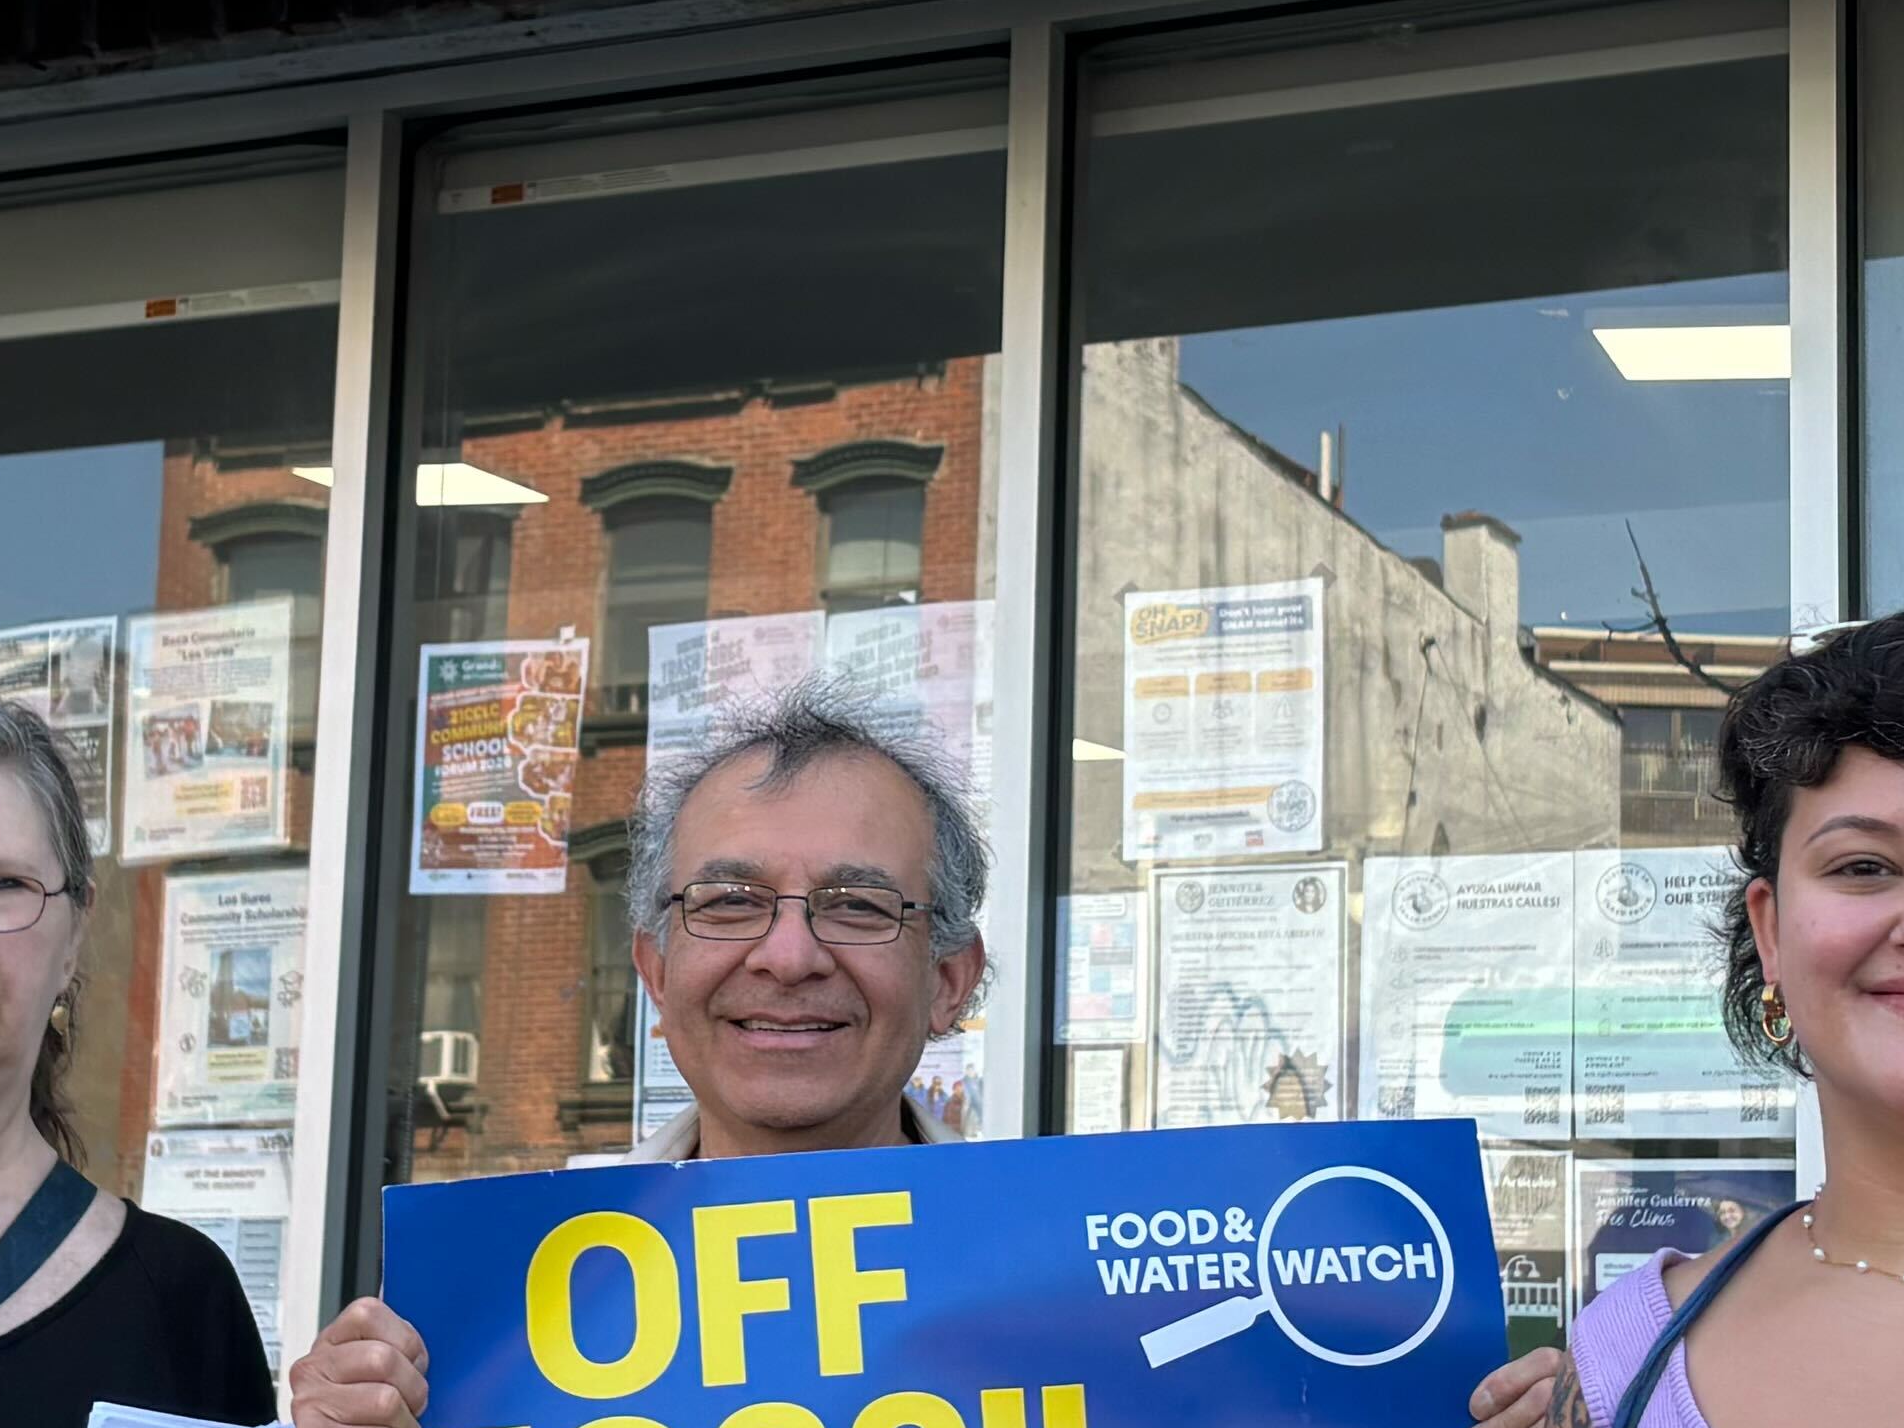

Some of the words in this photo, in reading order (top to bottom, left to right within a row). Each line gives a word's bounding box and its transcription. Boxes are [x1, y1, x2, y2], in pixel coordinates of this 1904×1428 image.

[1139, 604, 1166, 620] OH
[1135, 612, 1203, 639] SNAP!
[1664, 876, 1696, 888] HELP
[1456, 884, 1496, 895] AYUDA
[1456, 896, 1513, 909] NUESTRAS
[1664, 892, 1693, 905] OUR
[1096, 1251, 1256, 1295] WATER
[1271, 1241, 1437, 1287] WATCH
[526, 1191, 913, 1400] OFF
